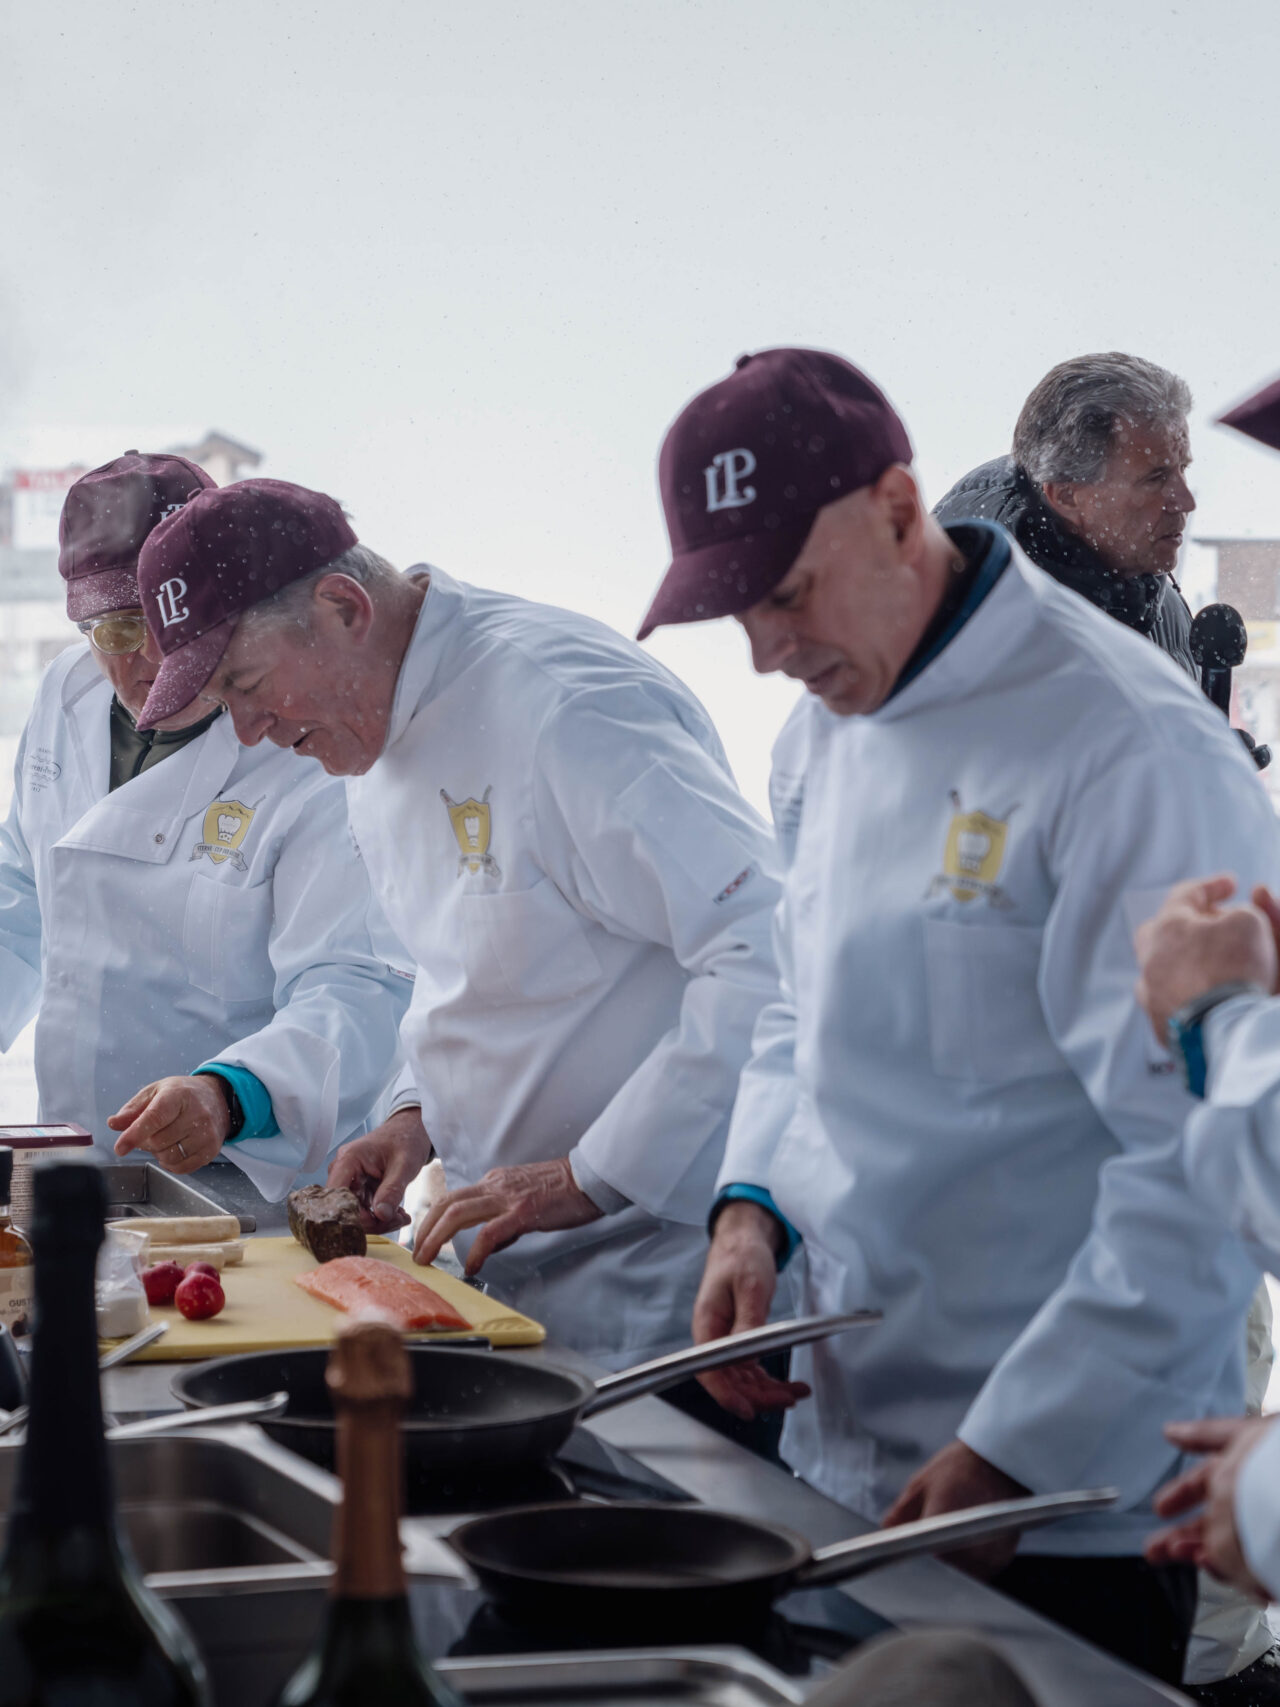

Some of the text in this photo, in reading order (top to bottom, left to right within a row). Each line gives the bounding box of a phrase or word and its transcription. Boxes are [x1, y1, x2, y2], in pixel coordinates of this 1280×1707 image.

[704, 447, 757, 513] LP
[155, 577, 190, 628] LP
[9, 1297, 33, 1307] GUST
